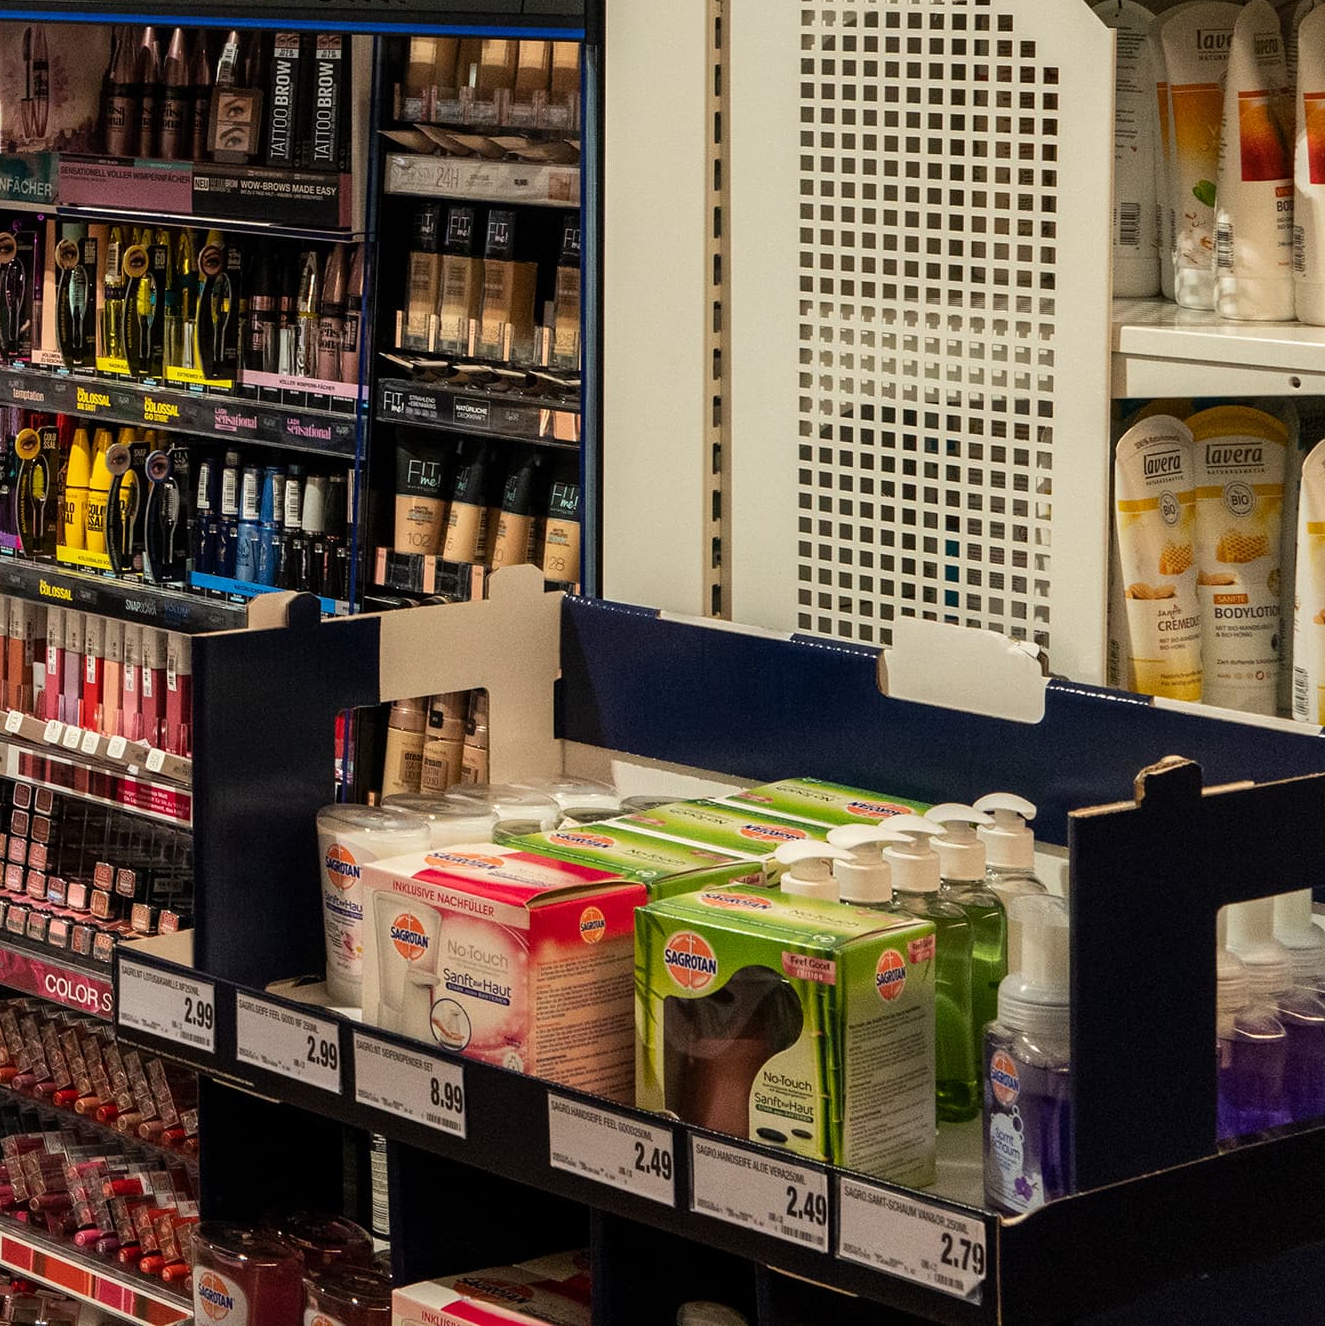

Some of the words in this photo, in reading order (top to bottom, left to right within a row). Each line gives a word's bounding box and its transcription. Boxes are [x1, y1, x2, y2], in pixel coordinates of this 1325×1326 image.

[274, 60, 291, 106] BROW
[317, 62, 334, 107] BROW
[270, 108, 287, 159] TATTOO
[314, 108, 329, 162] TATTOO
[194, 178, 209, 190] NEU
[240, 180, 290, 193] WOW-BROWS
[291, 183, 316, 195] MADE
[317, 185, 337, 196] EASY
[12, 388, 45, 402] temptation
[77, 390, 111, 407] COLOSSAL
[144, 400, 180, 417] COLOSSAL
[455, 403, 488, 415] NATÜRLICHE
[215, 413, 258, 430] sensational
[287, 424, 332, 440] sensational
[1143, 449, 1181, 476] lavera
[1205, 445, 1263, 466] lavera
[1231, 494, 1249, 506] BIO
[406, 533, 431, 548] 102
[39, 583, 73, 601] COLOSSAL
[325, 856, 361, 878] SAGROTAN
[393, 880, 435, 901] INKLUSIVE
[437, 892, 495, 917] NACHFÜLLER
[391, 926, 429, 948] SAGROTAN
[580, 920, 605, 932] SAGROTAN
[664, 946, 717, 975] SAGROTAN
[789, 955, 803, 969] Feel
[804, 957, 831, 972] Good
[44, 973, 98, 1009] COLOR
[443, 968, 473, 988] Sanft
[483, 978, 511, 998] Haut
[184, 997, 213, 1030] 2.99
[307, 1035, 338, 1071] 2.99
[423, 1061, 434, 1073] SET
[430, 1076, 463, 1114] 8.99
[754, 1092, 781, 1108] Sanft
[789, 1098, 814, 1117] Haut
[603, 1116, 617, 1130] FEEL
[634, 1141, 673, 1181] 2.49
[752, 1159, 770, 1173] ALOE
[786, 1186, 827, 1227] 2.49
[940, 1232, 985, 1275] 2.79
